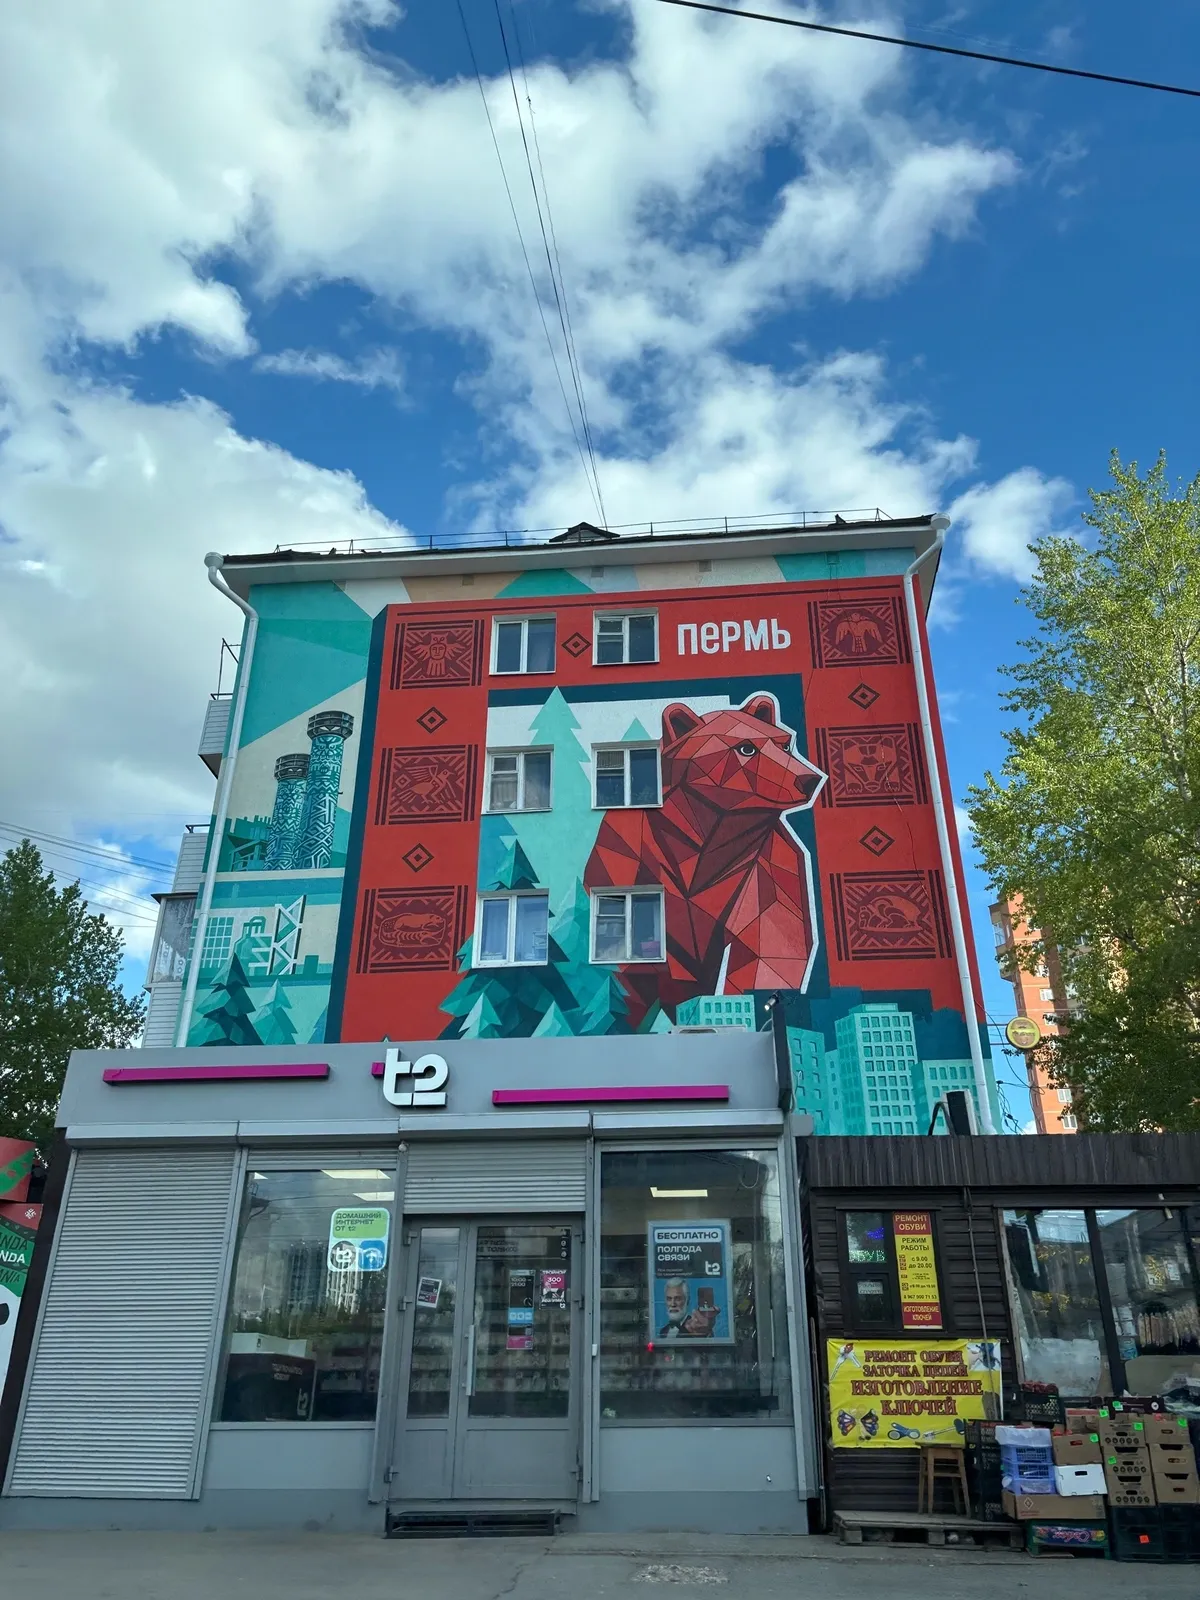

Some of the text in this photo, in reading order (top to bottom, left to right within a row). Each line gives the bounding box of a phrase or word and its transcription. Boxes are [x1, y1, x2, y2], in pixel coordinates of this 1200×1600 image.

[382, 1047, 449, 1107] t2
[895, 1214, 928, 1222] РЕМОНТ
[898, 1222, 927, 1231] ОБУВИ
[656, 1231, 719, 1240] БЕСПЛАТНО
[657, 1245, 702, 1254] ПОЛГОДА
[900, 1244, 930, 1252] РАБОТЫ
[657, 1253, 690, 1262] СВЯЗИ
[704, 1260, 720, 1276] t2
[912, 1313, 932, 1321] КЛЮЧЕЙ
[864, 1350, 917, 1362] РЕМОНТ
[862, 1363, 968, 1378] ЗАТОЧКА ЦЕПЕЙ
[851, 1380, 983, 1395] ИЗГОТОВЛЕНИЕ
[880, 1396, 958, 1415] КЛЮЧЕЙ
